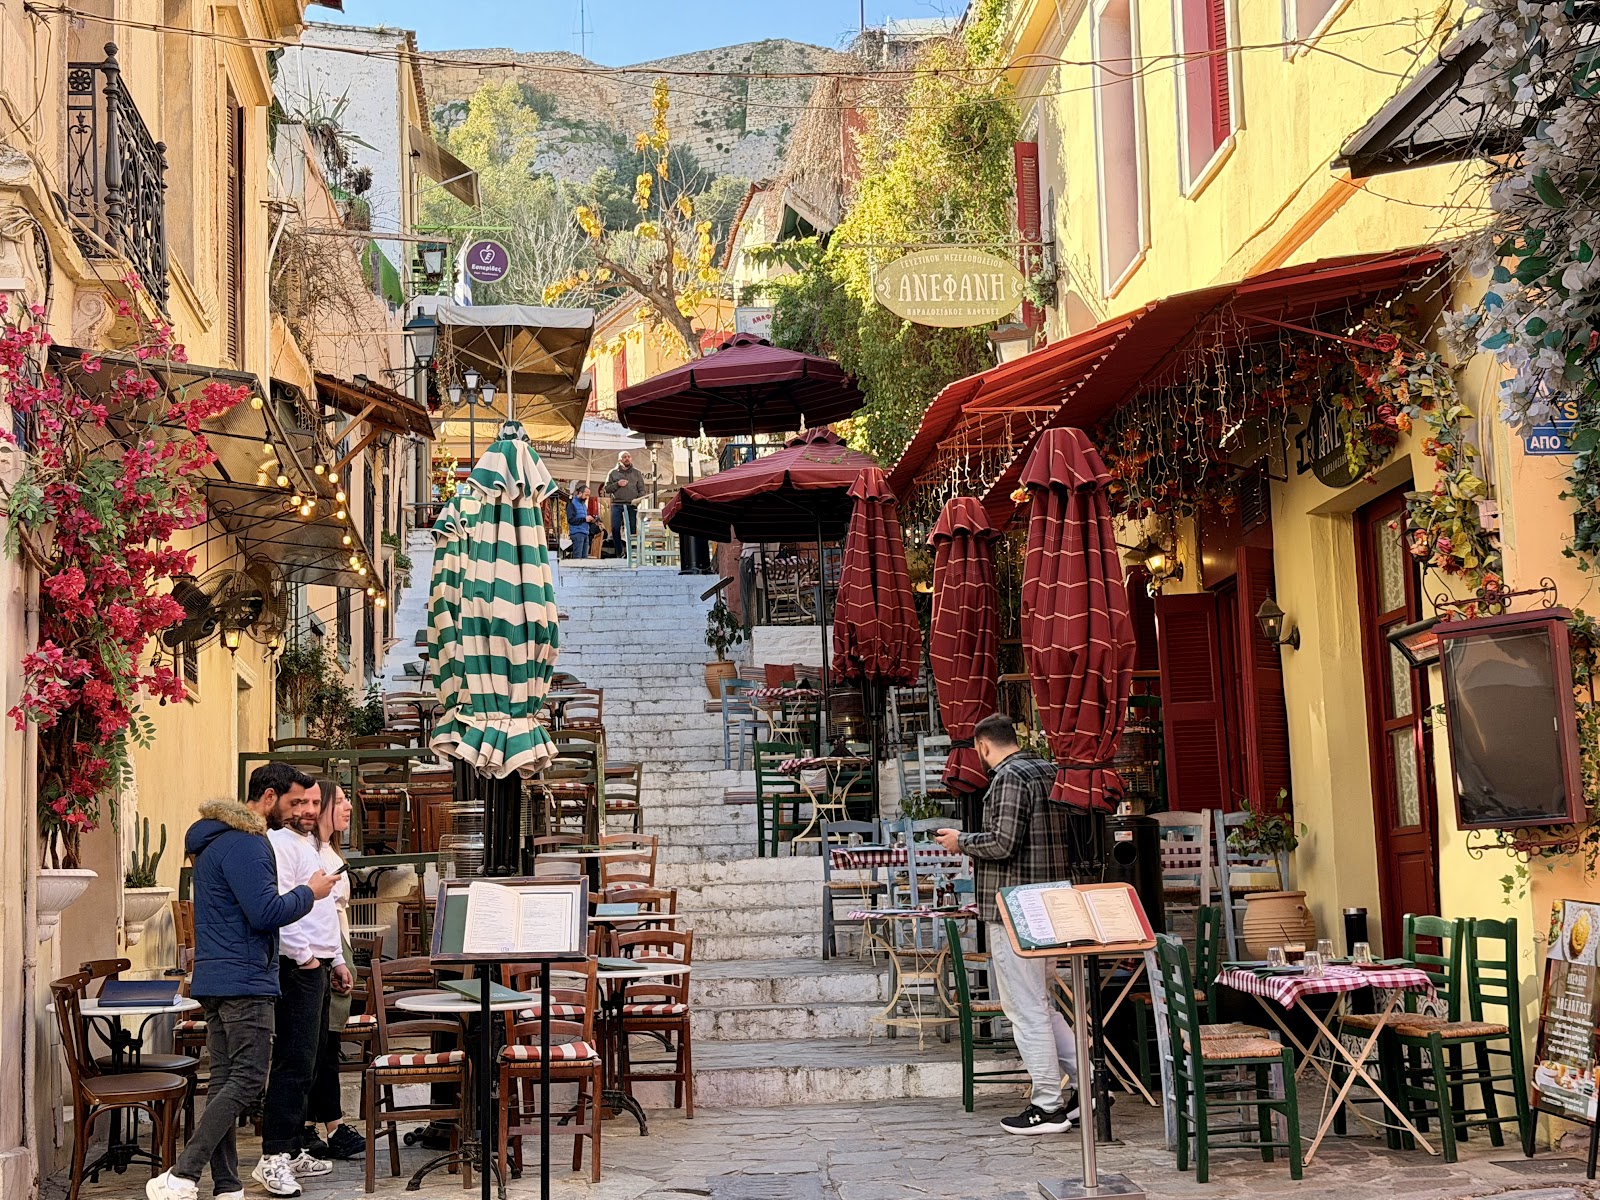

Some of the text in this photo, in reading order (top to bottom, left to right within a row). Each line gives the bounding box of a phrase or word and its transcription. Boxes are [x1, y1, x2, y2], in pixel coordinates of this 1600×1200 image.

[900, 253, 1004, 269] ΓΕΥΣΤΙΚΟΝ ΜΕΖΕΔΟΠΩΛΕΙΟΝ
[898, 273, 1006, 302] ΑΝΕΦΑΝΗ
[751, 313, 772, 324] ΑΝΑΦ
[906, 308, 963, 316] ΠΑΡΑΔΟΣΙΑΚΟΣ
[1530, 436, 1561, 449] ΑΠΟ
[1556, 996, 1592, 1016] BREAKFAST
